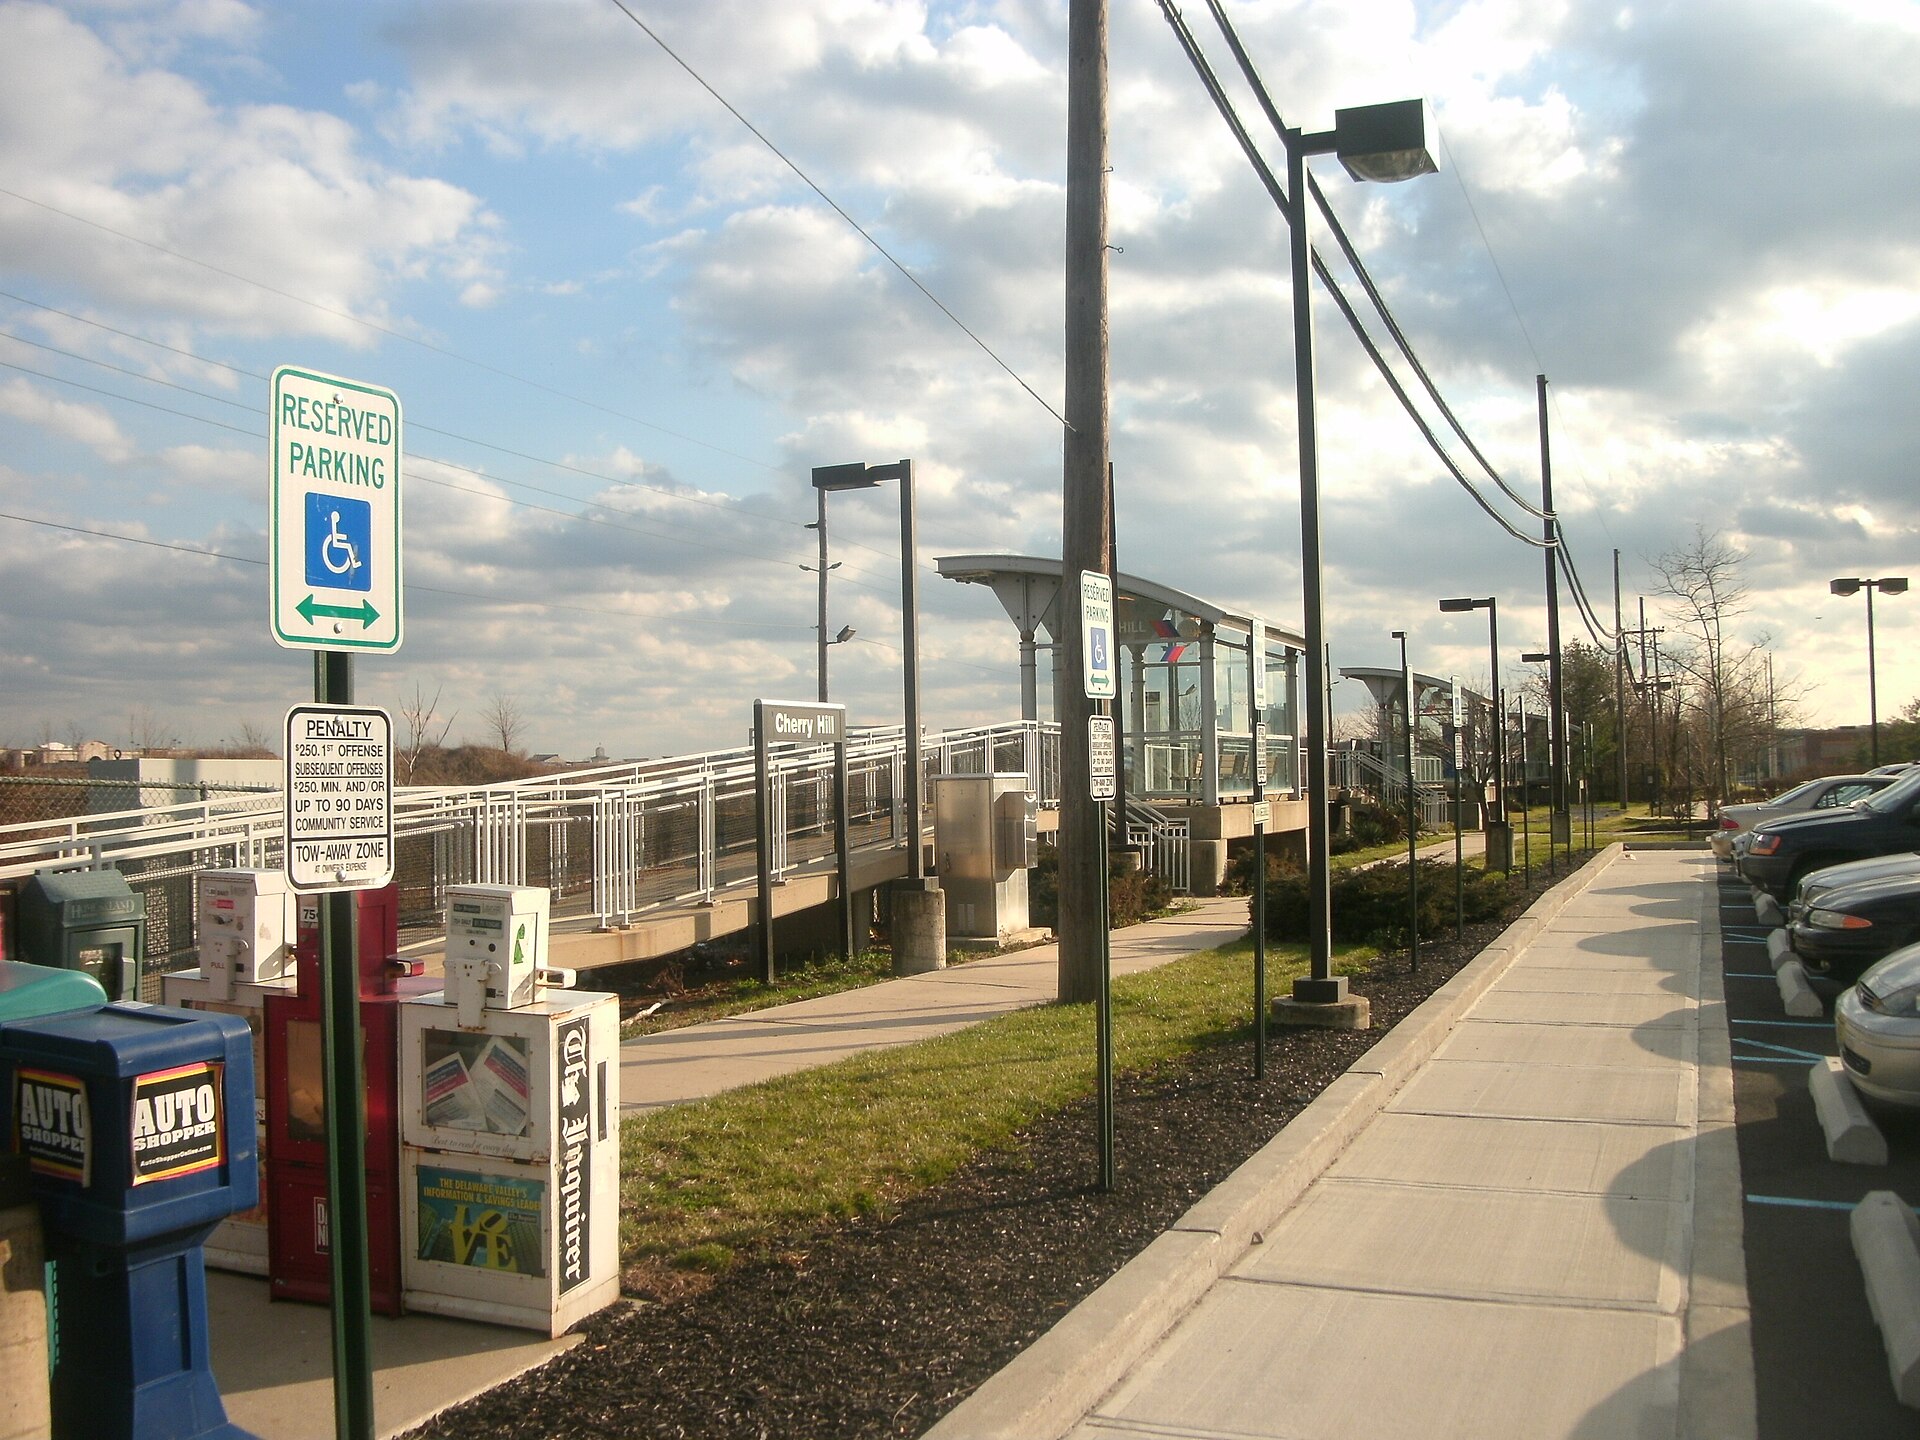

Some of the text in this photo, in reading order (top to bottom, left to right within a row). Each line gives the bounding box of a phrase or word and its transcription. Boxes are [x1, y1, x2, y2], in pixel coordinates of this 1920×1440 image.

[283, 393, 391, 446] RESERVED
[290, 442, 384, 489] PARKING
[1084, 583, 1109, 602] RESERVED
[1119, 621, 1146, 633] HILL
[307, 719, 372, 737] PENALTY
[775, 712, 835, 739] Cherry Hill
[338, 745, 383, 757] OFFENSE
[295, 762, 383, 776] SUBSEQUENT OFFENSES
[294, 780, 385, 793] $250. MIN. AND/OR
[295, 798, 383, 812] UP TO 90 DAYS
[295, 816, 384, 831] COMMUNITY SERVICE
[296, 842, 384, 862] TOW-AWAY ZONE
[346, 862, 367, 871] EXPENSE
[134, 1084, 215, 1138] AUTO
[134, 1121, 216, 1151] SHOPPER
[424, 1187, 474, 1202] INFORMATION
[484, 1195, 514, 1207] SAVINGS
[440, 1178, 528, 1198] THE DELAWARE VALLEY'S
[560, 1113, 589, 1280] Inquirer
